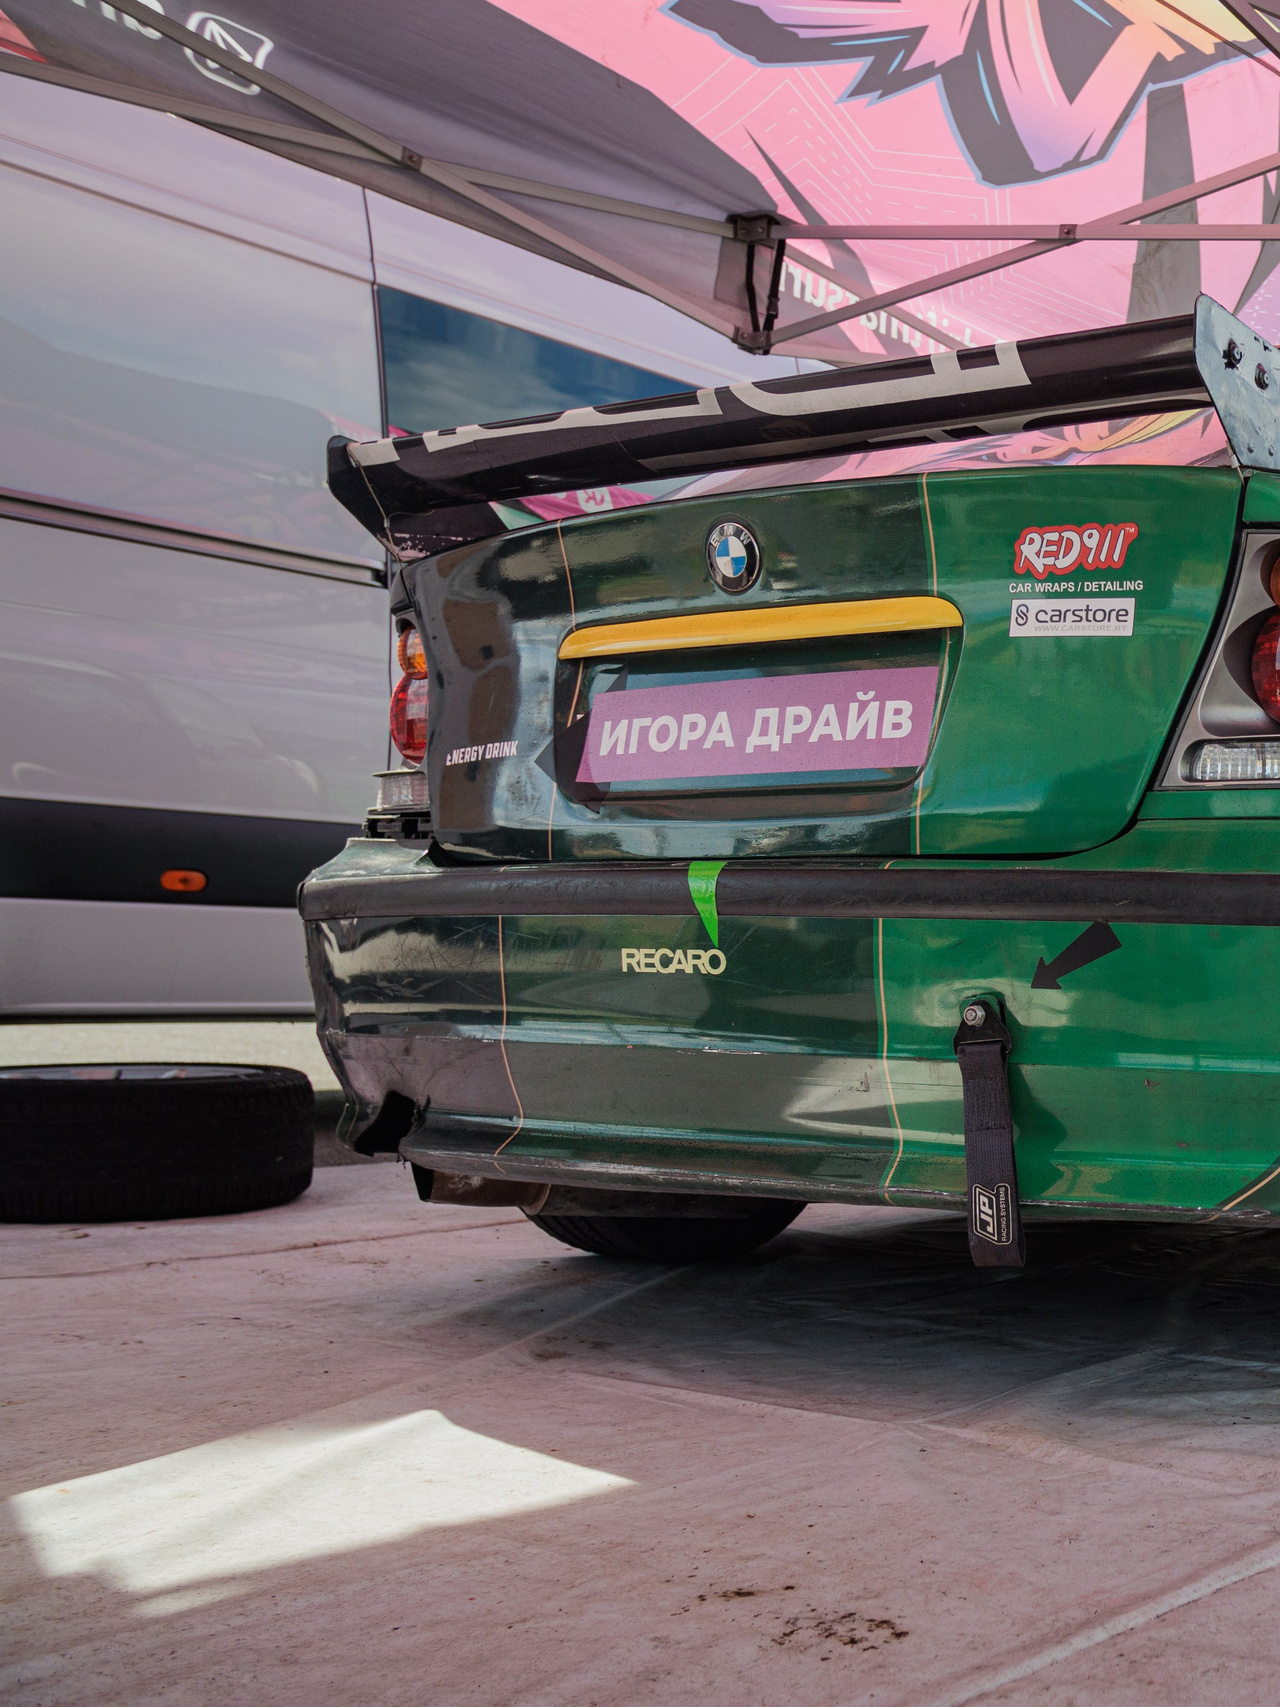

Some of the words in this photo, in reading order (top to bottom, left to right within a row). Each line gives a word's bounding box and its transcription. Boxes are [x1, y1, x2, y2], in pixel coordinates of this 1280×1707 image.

[710, 525, 751, 547] BMW
[1019, 528, 1125, 573] RED911
[1009, 582, 1031, 593] CAR
[1035, 582, 1075, 592] WRAPS
[1084, 580, 1144, 592] DETAILING
[1035, 604, 1129, 623] carstore
[1034, 624, 1127, 632] WWW.CARSTORE.BY
[599, 711, 735, 756] ИГОРА
[745, 691, 914, 753] ДРАЙВ
[485, 740, 518, 759] DRINK
[621, 948, 727, 975] RECARO
[980, 1194, 993, 1234] JP
